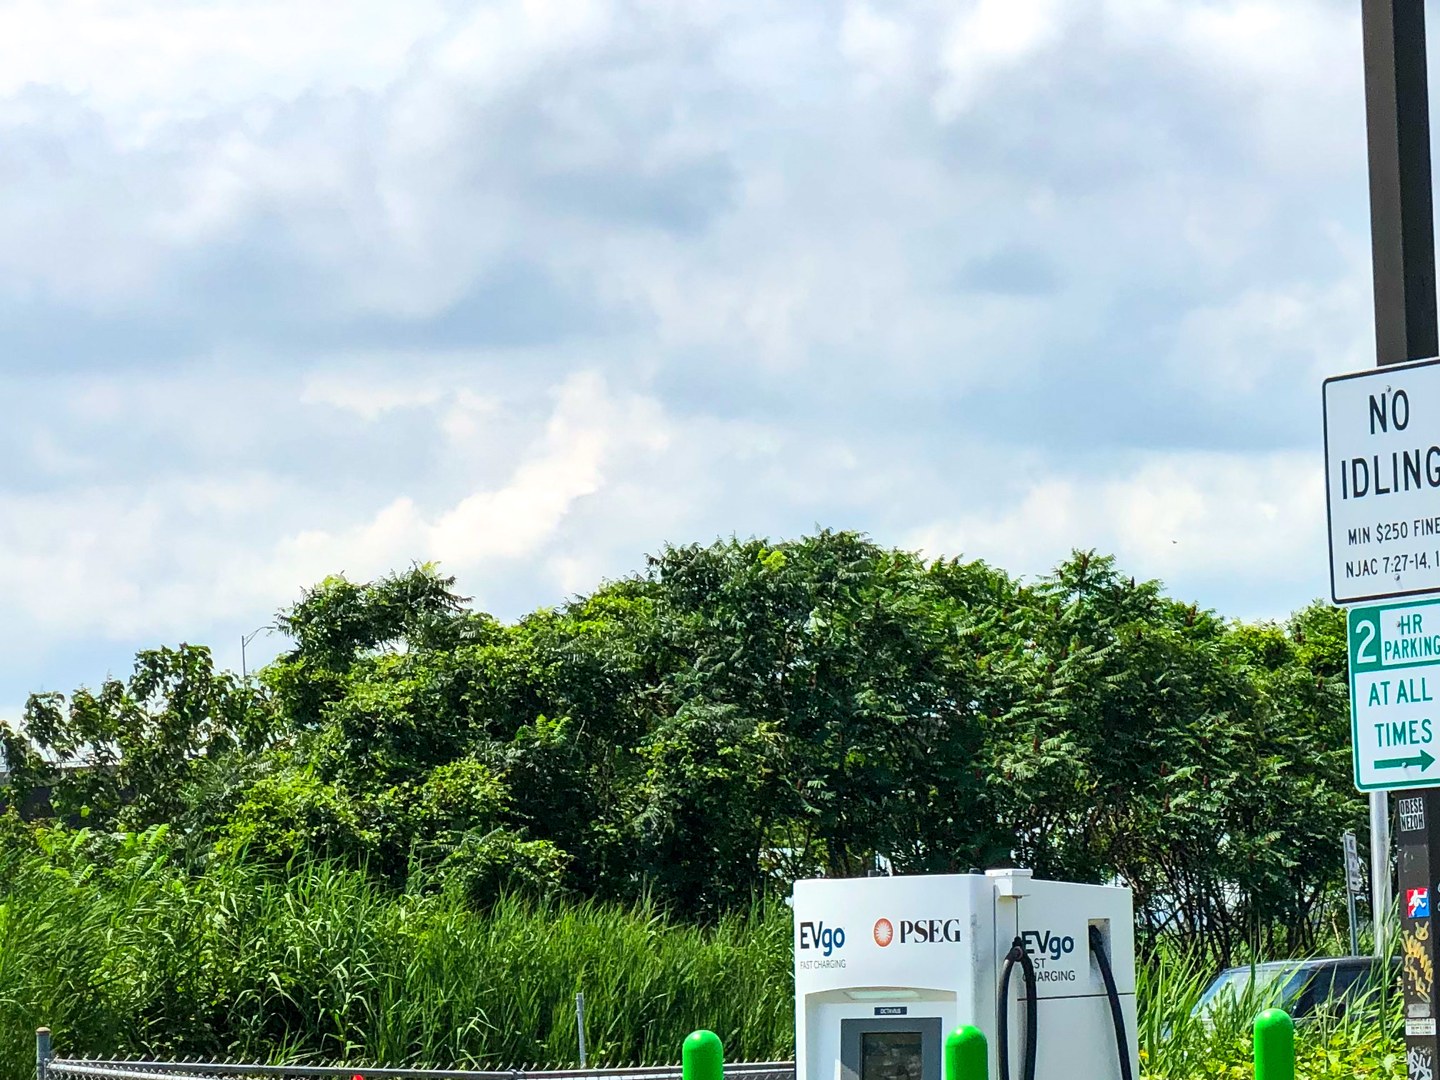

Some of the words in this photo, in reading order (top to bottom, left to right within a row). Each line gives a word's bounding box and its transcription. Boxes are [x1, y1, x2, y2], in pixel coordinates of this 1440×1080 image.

[1369, 389, 1410, 435] NO
[1348, 526, 1370, 546] MIN
[1376, 521, 1408, 544] $250
[1346, 558, 1378, 578] NJAC
[1383, 552, 1431, 574] 7:27-14,
[1400, 614, 1422, 635] HR
[1355, 619, 1377, 664] 2
[1384, 635, 1440, 661] PARKING
[1368, 681, 1390, 707] AT
[1396, 677, 1433, 704] ALL
[1374, 719, 1433, 748] TIMES
[800, 921, 845, 957] EVgo
[900, 919, 961, 944] PSEG
[1021, 930, 1074, 961] EVgo
[800, 960, 813, 969] FAST
[813, 959, 846, 969] CHARGING
